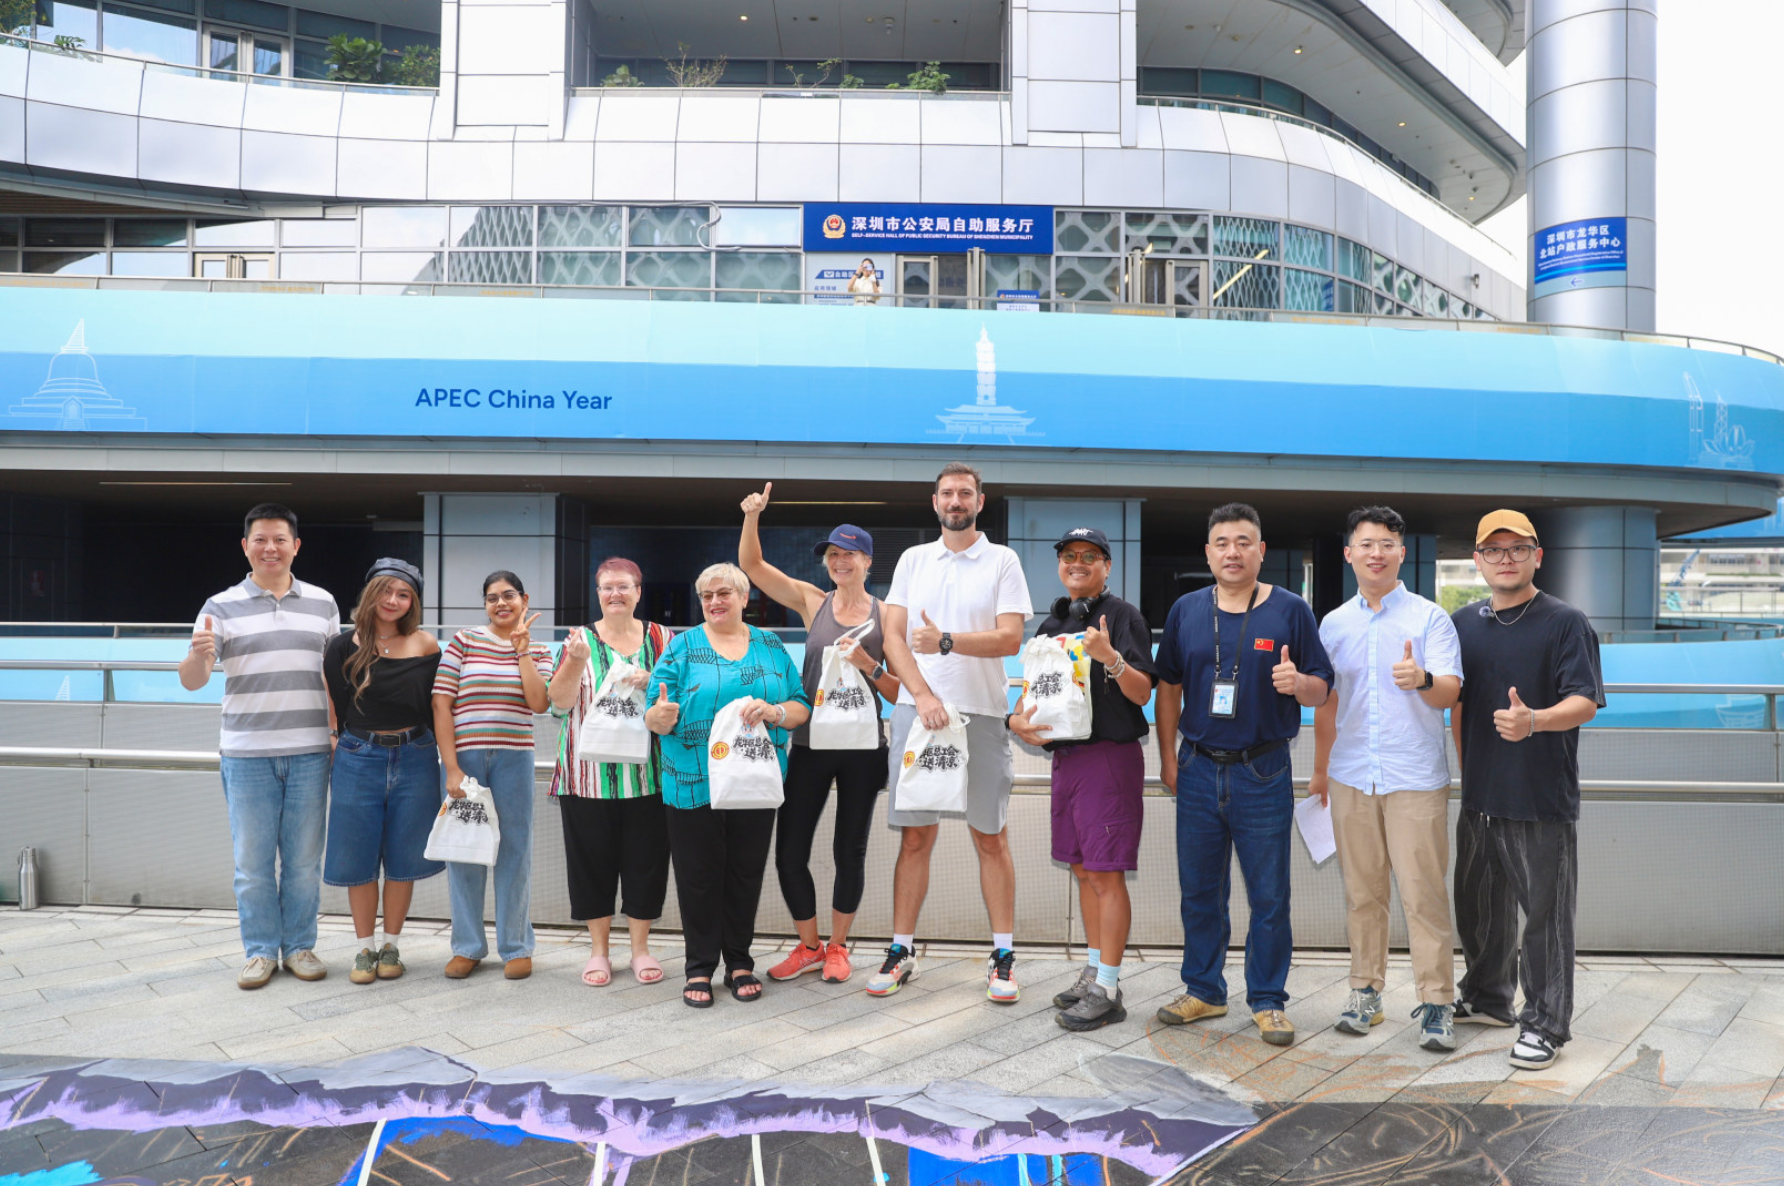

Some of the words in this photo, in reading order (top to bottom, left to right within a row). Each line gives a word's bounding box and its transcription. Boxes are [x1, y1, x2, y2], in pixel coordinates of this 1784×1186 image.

[851, 216, 1034, 233] 深圳市公安局自助服务厅
[1546, 225, 1610, 245] 深圳市龙华区
[1540, 237, 1621, 259] 北站户政服务中心
[415, 388, 481, 408] APEC
[488, 389, 555, 409] China
[562, 390, 613, 410] Year
